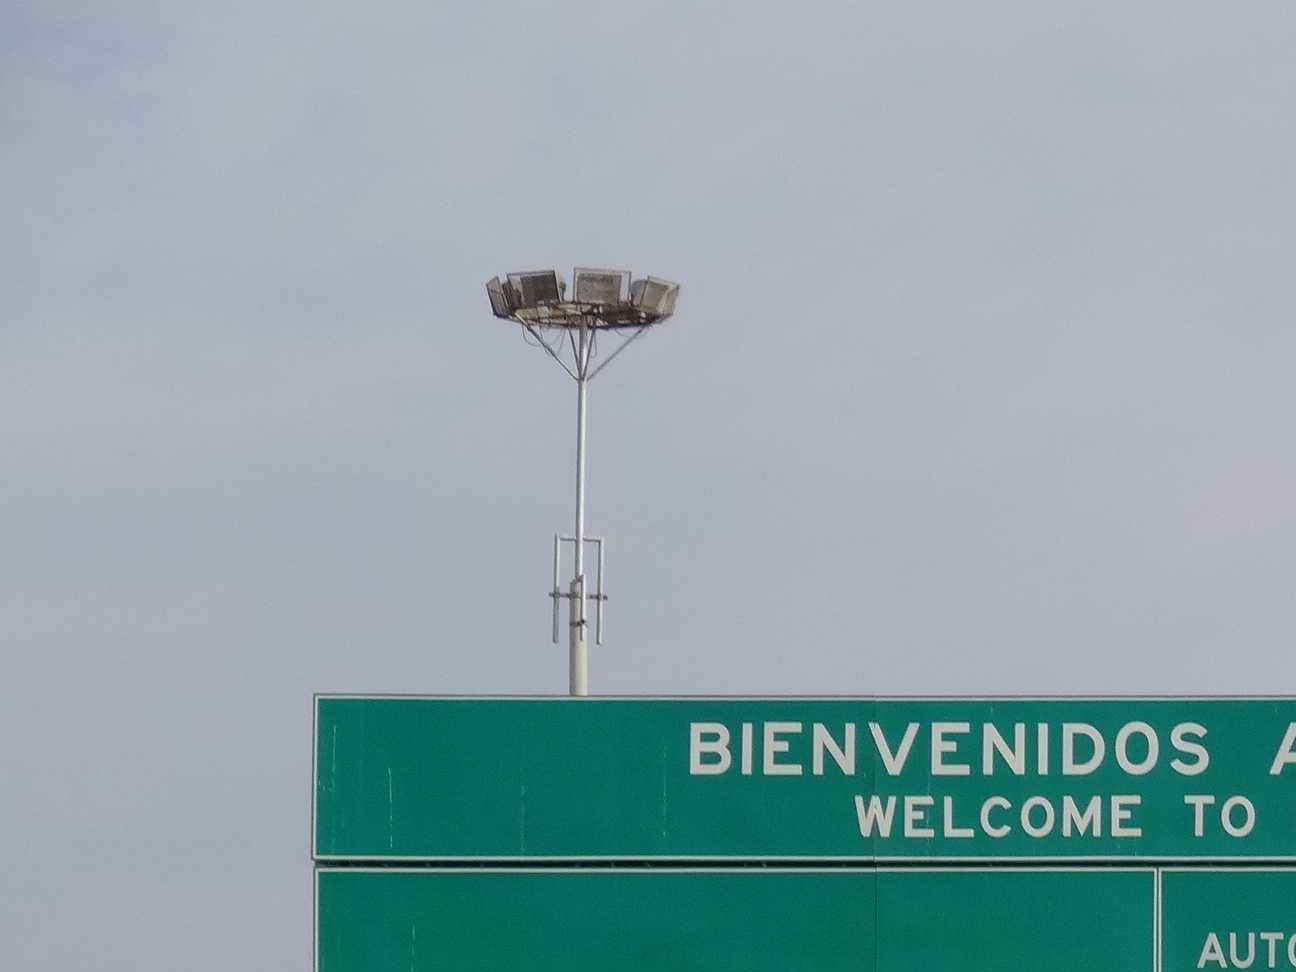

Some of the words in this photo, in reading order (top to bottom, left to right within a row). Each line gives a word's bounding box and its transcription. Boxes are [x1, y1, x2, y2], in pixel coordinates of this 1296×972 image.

[687, 720, 1211, 777] BIENVENIDOS
[854, 794, 1143, 839] WELCOME
[1184, 794, 1257, 838] TO
